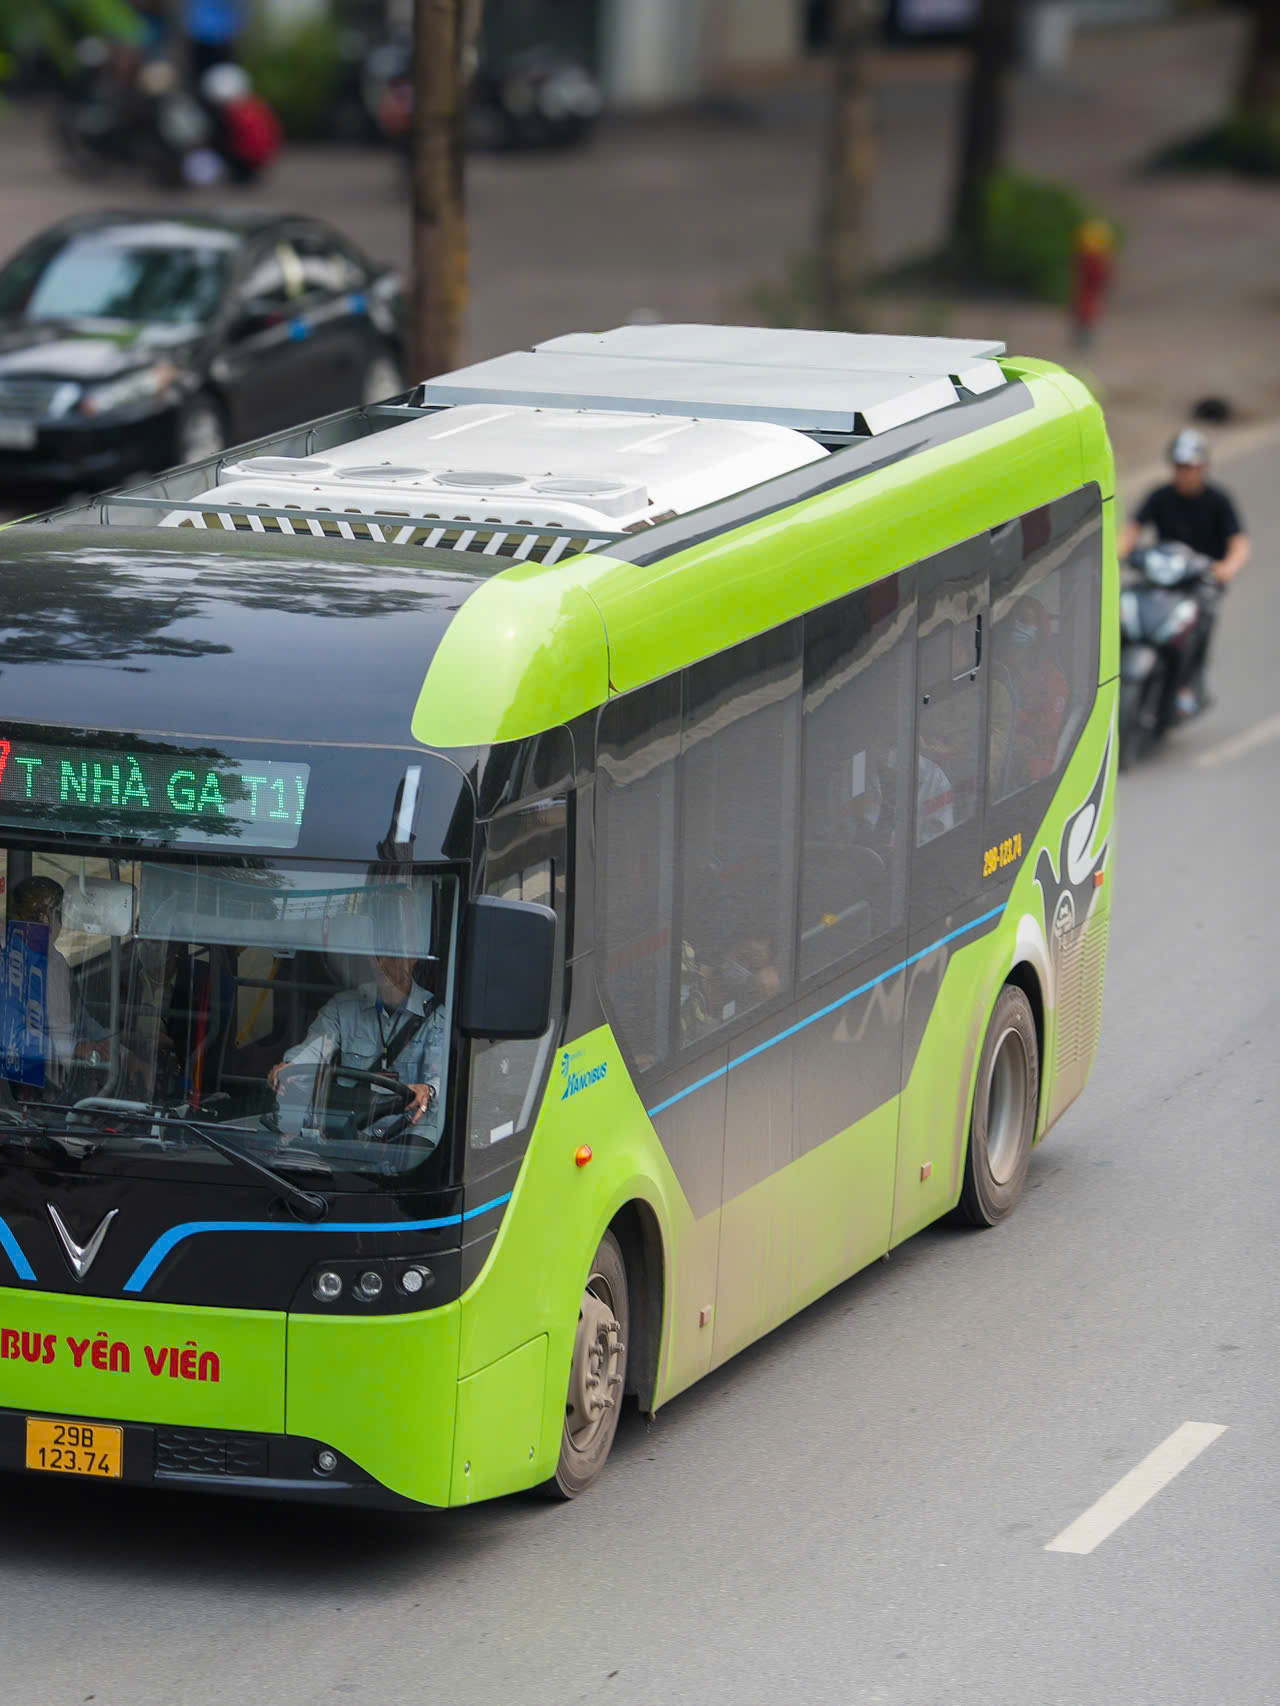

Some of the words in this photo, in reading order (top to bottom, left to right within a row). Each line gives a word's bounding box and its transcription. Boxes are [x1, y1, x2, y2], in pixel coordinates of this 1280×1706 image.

[14, 756, 43, 798] T
[60, 755, 150, 807] NHÀ
[166, 770, 225, 814] GA
[0, 1327, 57, 1365] BUS
[65, 1331, 131, 1374] YÊN
[143, 1340, 221, 1383] VIÊN
[53, 1424, 94, 1447] 29B
[38, 1447, 110, 1474] 123.74
